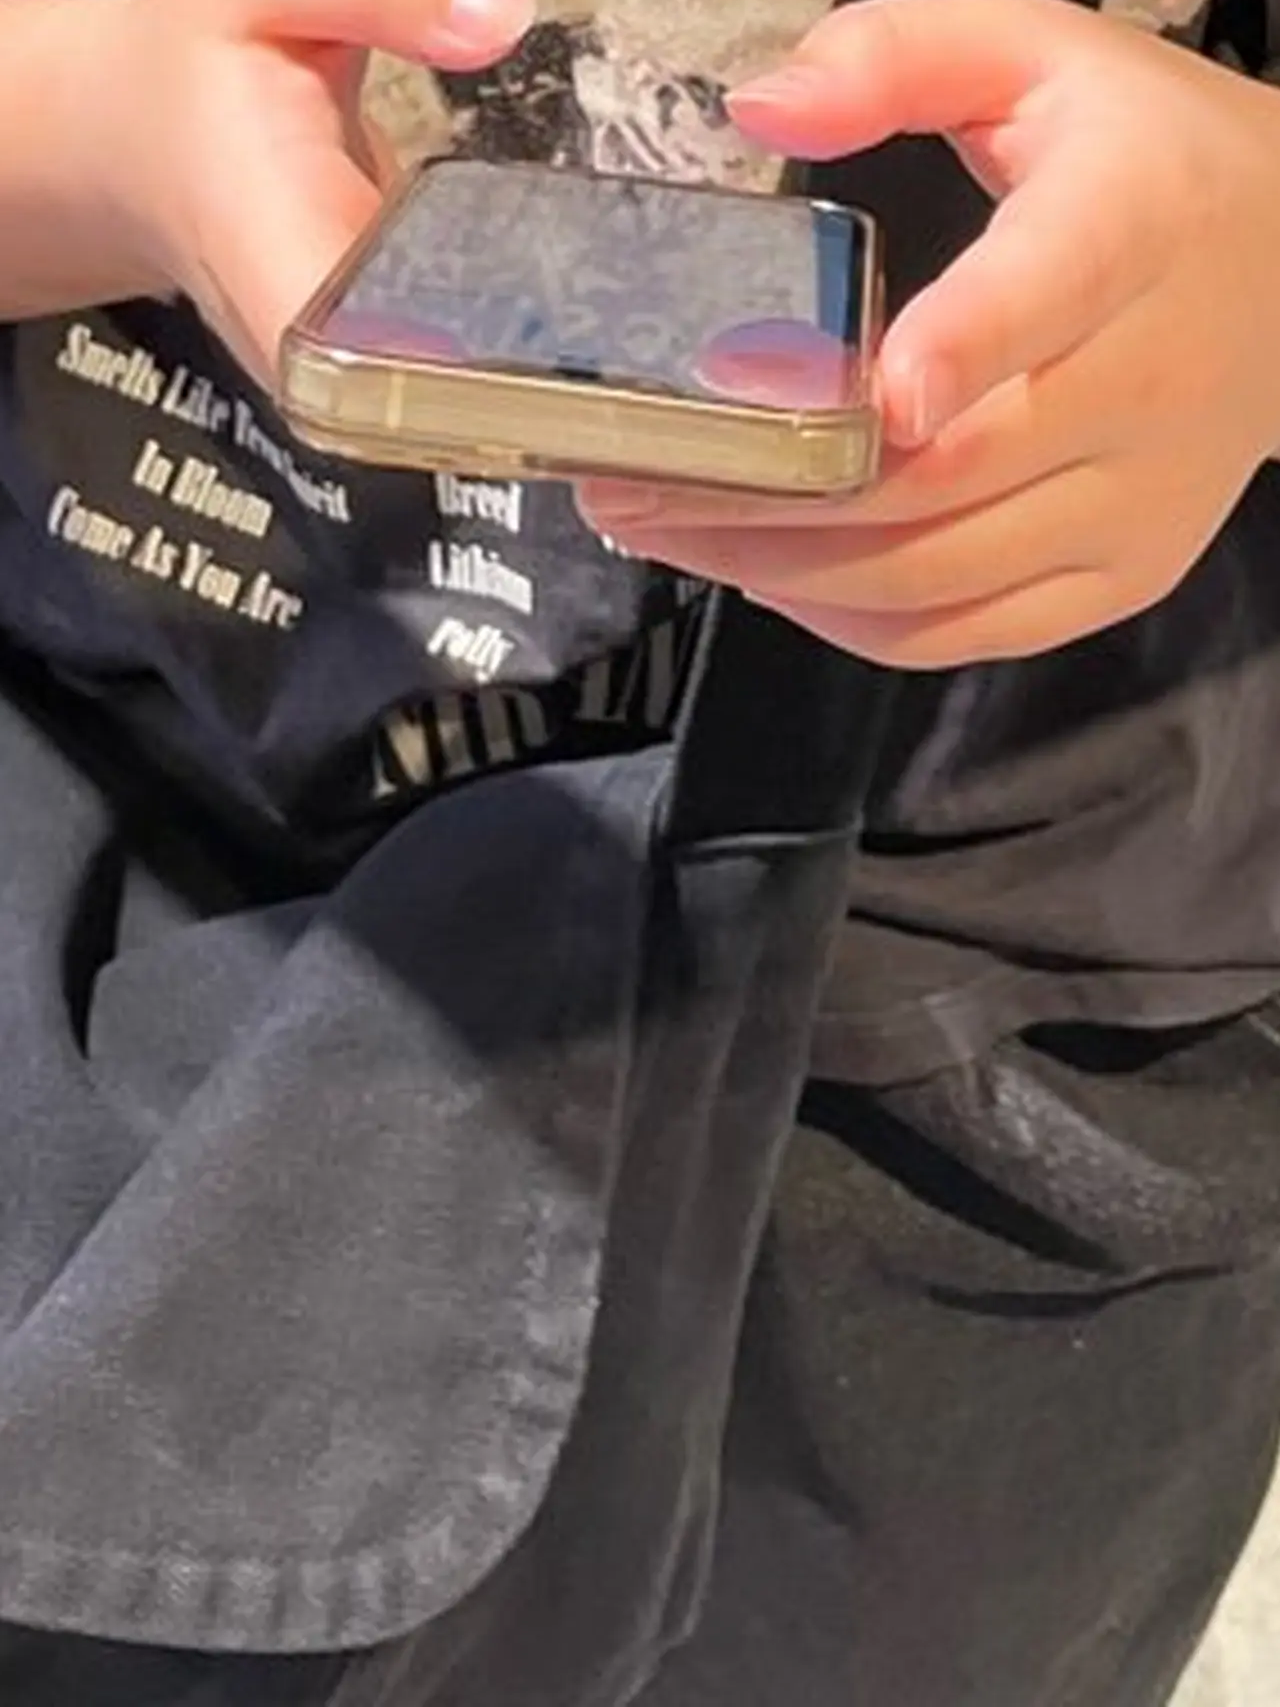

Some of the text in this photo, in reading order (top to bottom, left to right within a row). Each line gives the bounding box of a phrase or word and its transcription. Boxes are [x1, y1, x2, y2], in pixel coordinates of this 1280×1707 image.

[56, 323, 166, 406] Smells
[160, 363, 231, 433] Like
[132, 439, 273, 538] In Bloom
[47, 484, 304, 631] Come As You Are
[429, 540, 533, 616] Lithium
